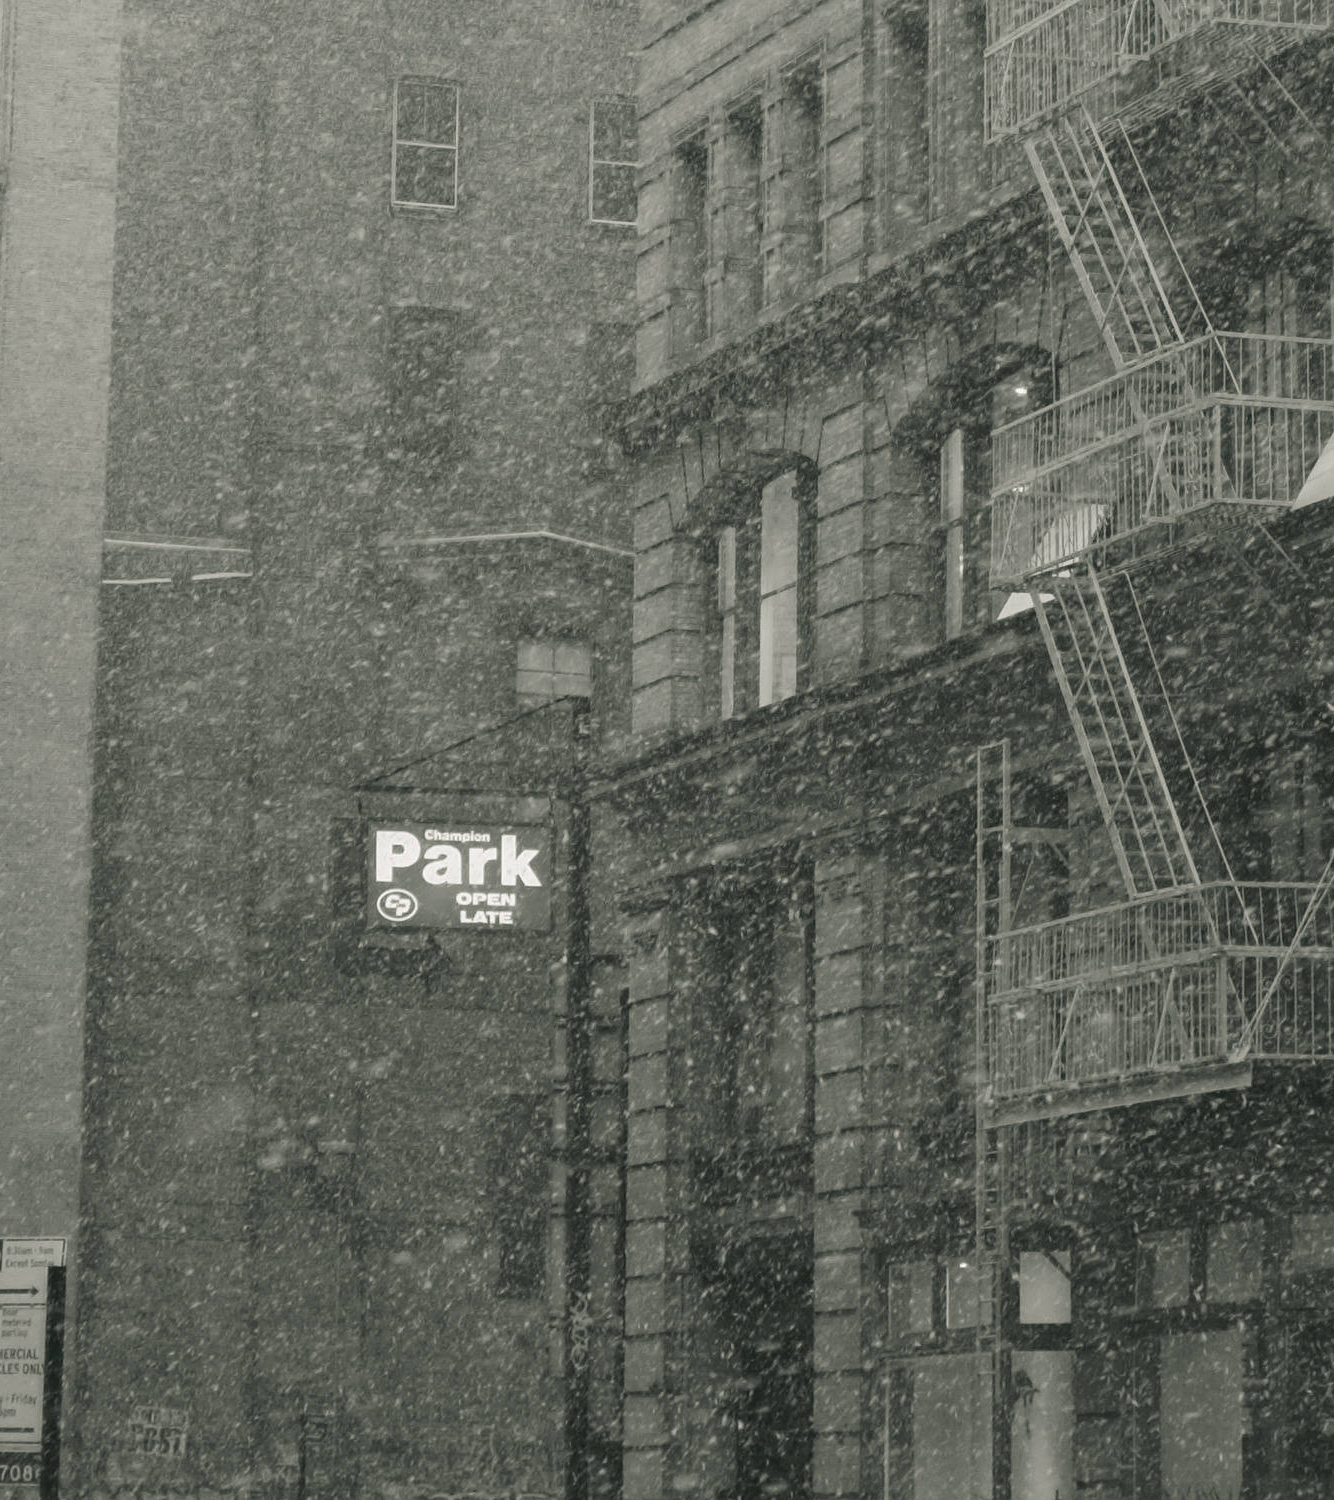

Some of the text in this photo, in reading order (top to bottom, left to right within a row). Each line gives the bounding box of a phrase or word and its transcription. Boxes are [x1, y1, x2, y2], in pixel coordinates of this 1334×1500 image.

[424, 829, 491, 843] Champion
[375, 830, 543, 888] Park
[455, 892, 516, 907] OPEN
[459, 910, 514, 925] LATE
[11, 1393, 37, 1407] Friday
